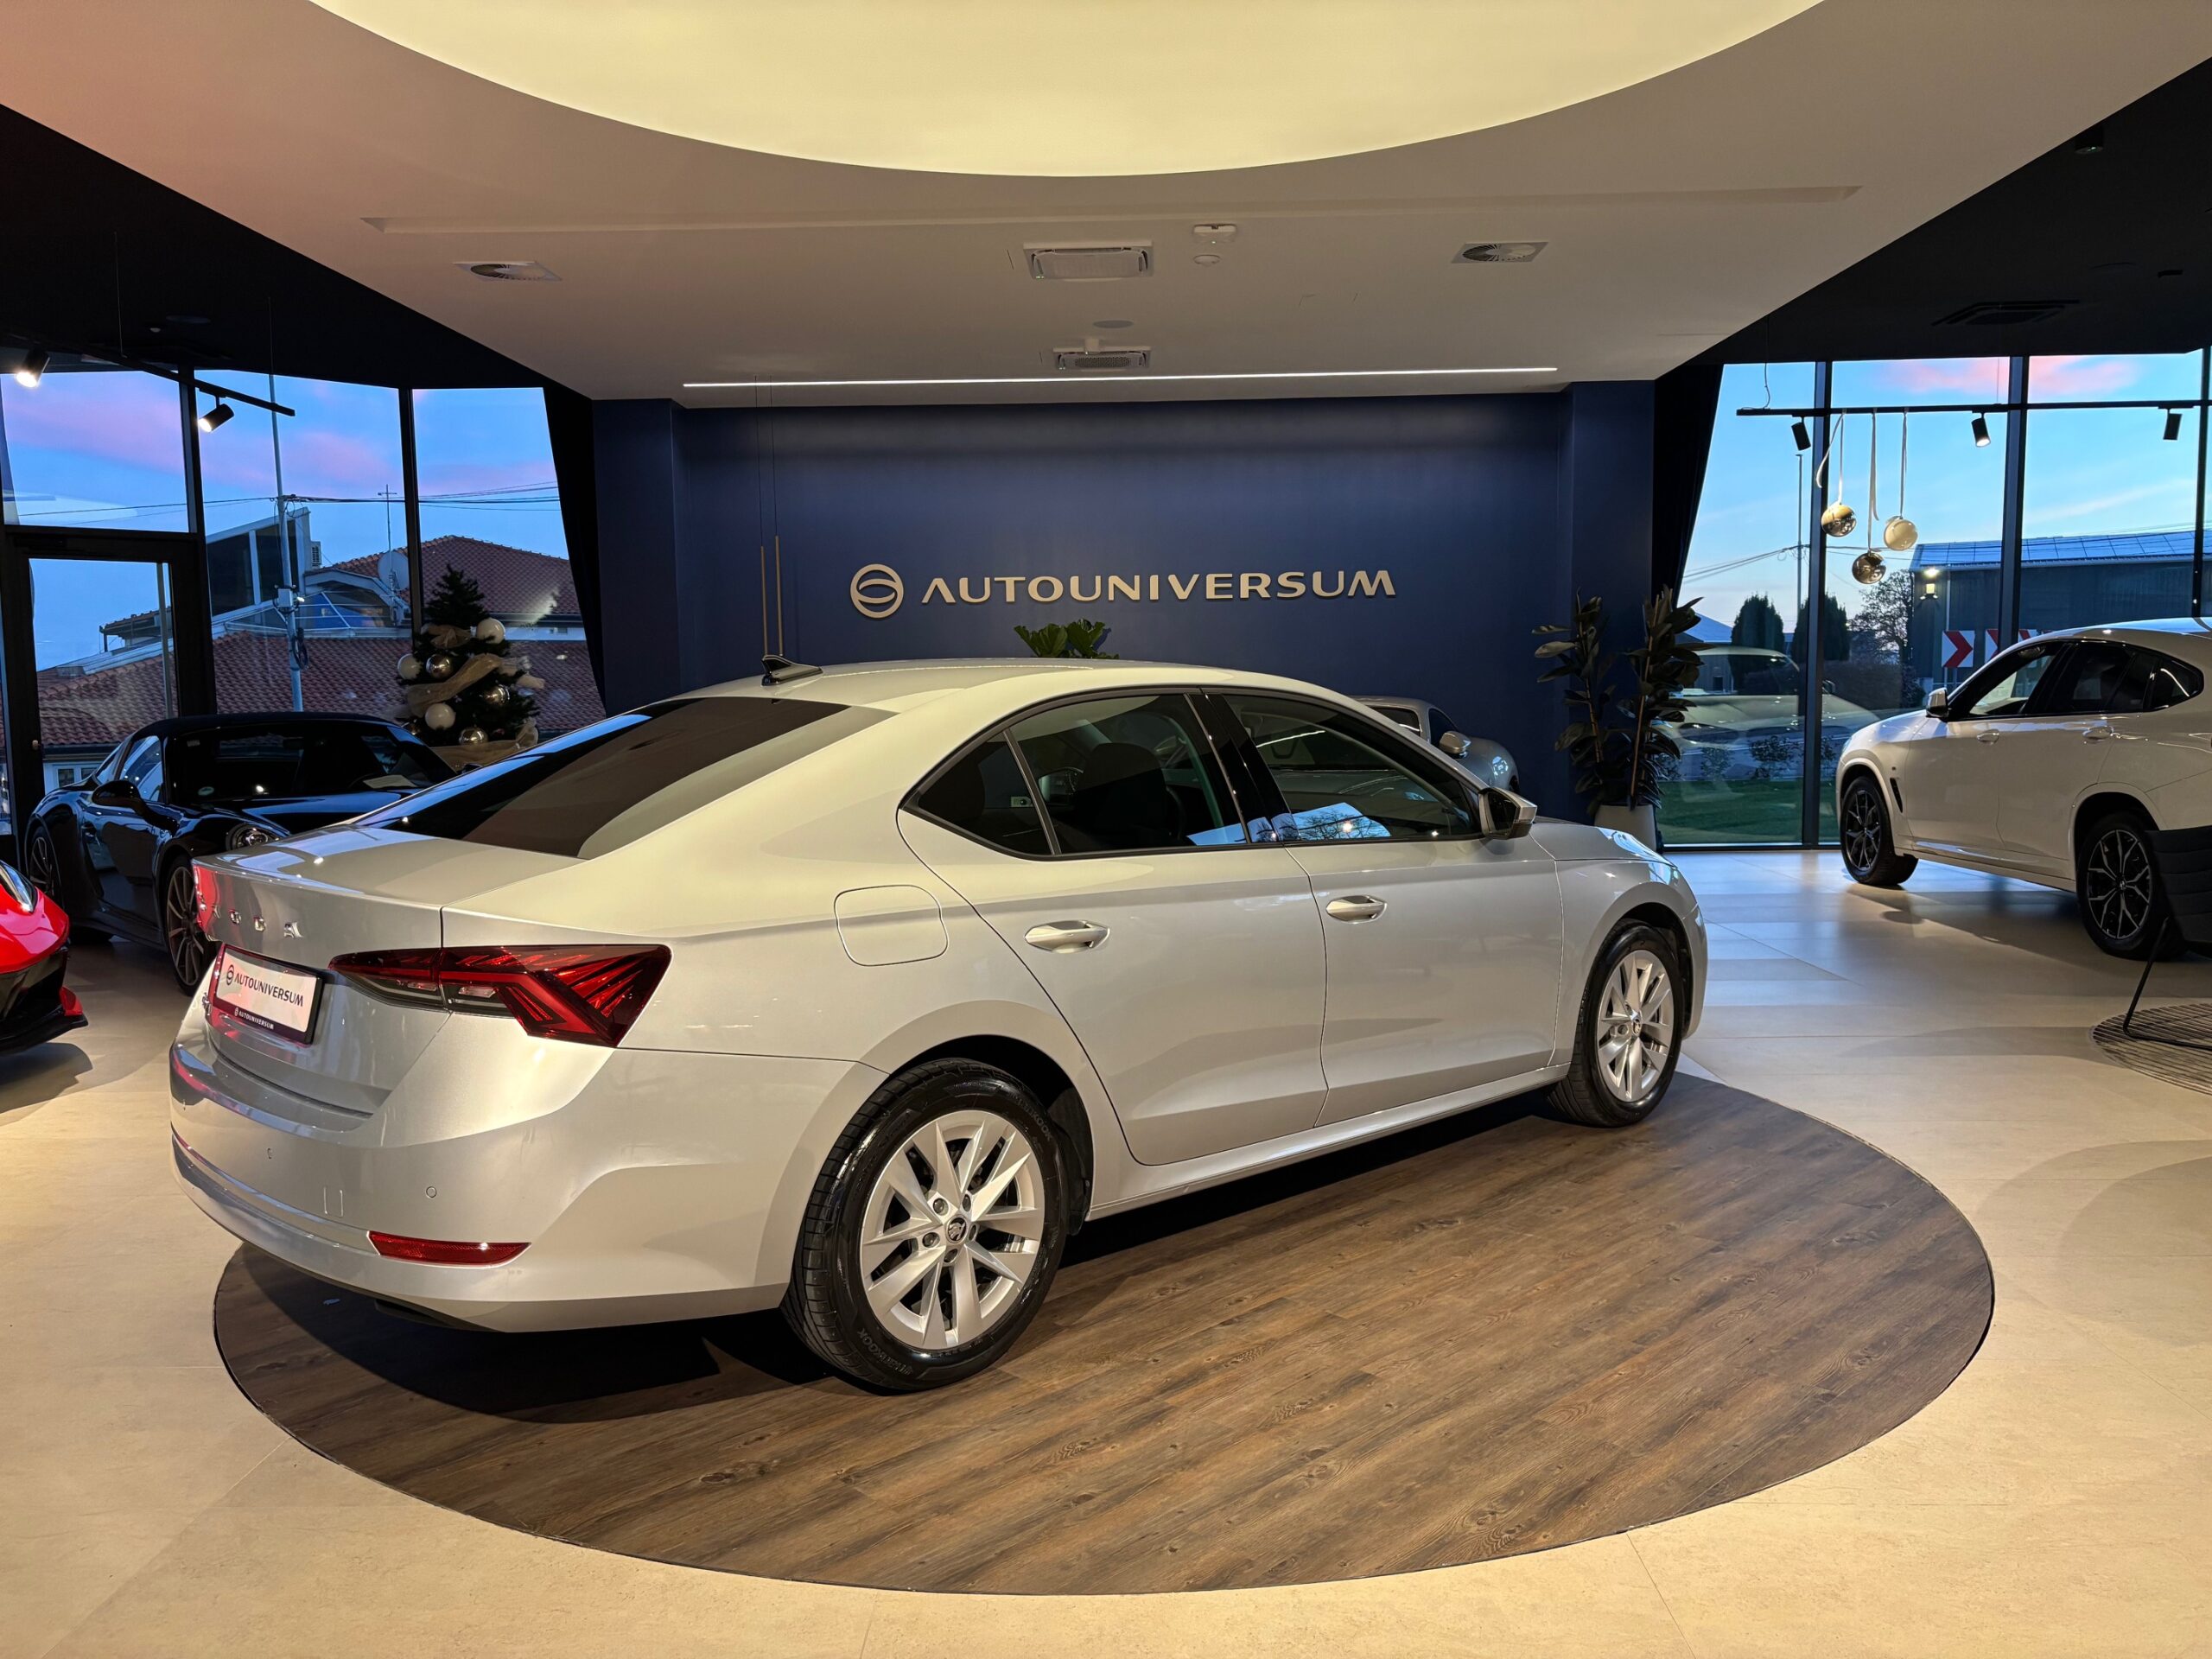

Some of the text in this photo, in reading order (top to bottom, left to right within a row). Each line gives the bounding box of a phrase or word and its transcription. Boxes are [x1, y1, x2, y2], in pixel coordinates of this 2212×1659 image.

[921, 569, 1396, 604] AUTOUNIVERSUM
[234, 972, 304, 1007] AUTOUNIVERSUM
[238, 1010, 275, 1030] AUTOUNIVERSUM
